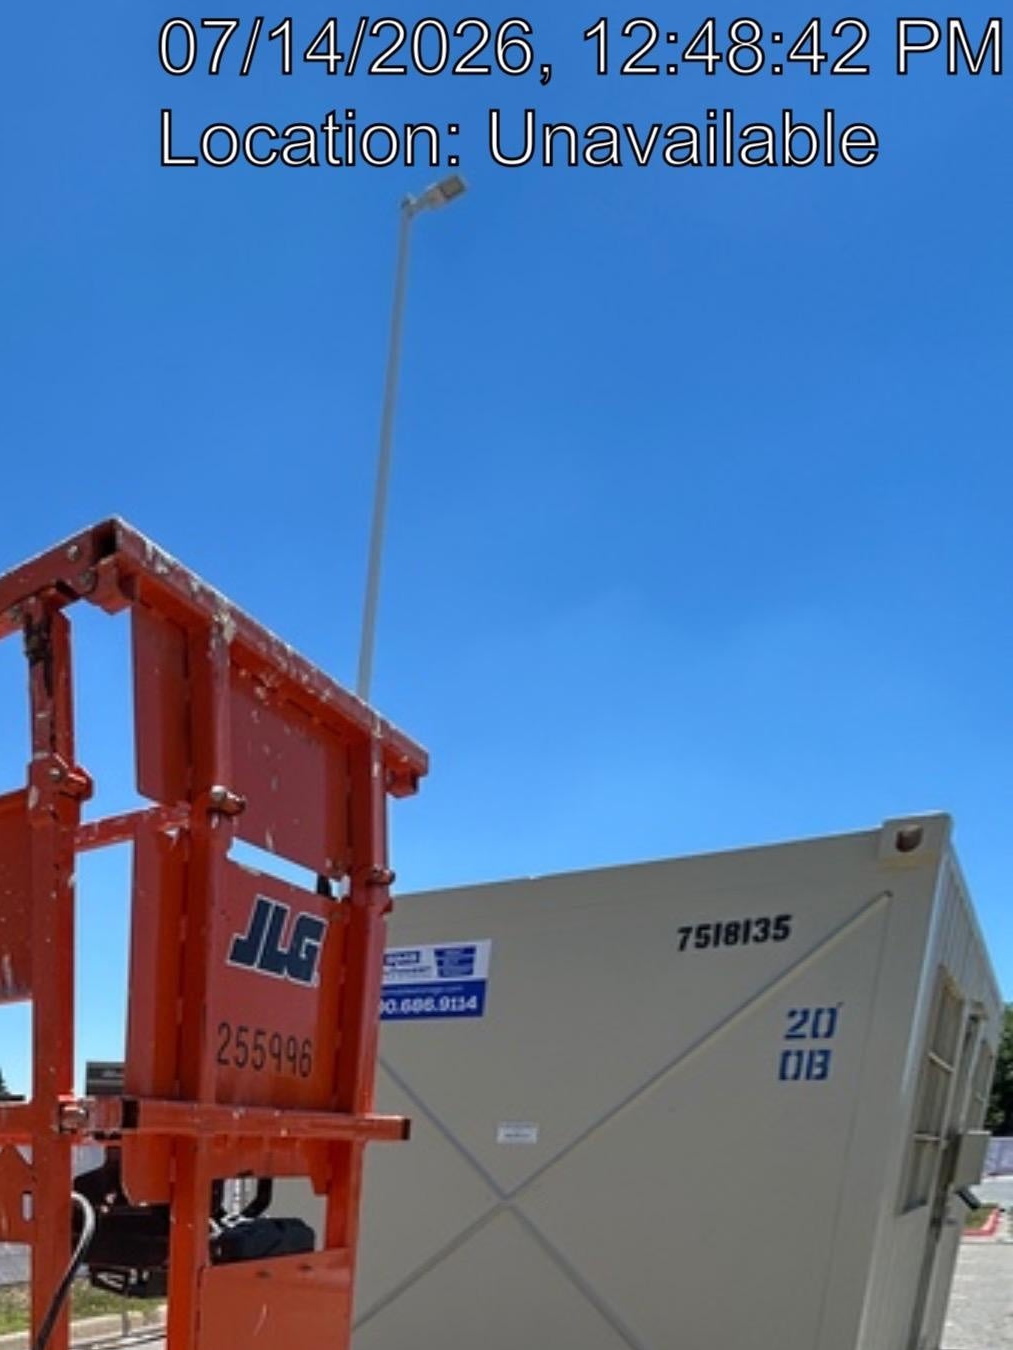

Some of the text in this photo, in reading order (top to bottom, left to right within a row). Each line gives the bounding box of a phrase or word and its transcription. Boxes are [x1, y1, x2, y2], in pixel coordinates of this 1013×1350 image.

[227, 894, 328, 988] JLG
[676, 913, 794, 952] 7518135
[216, 1021, 313, 1078] 255996
